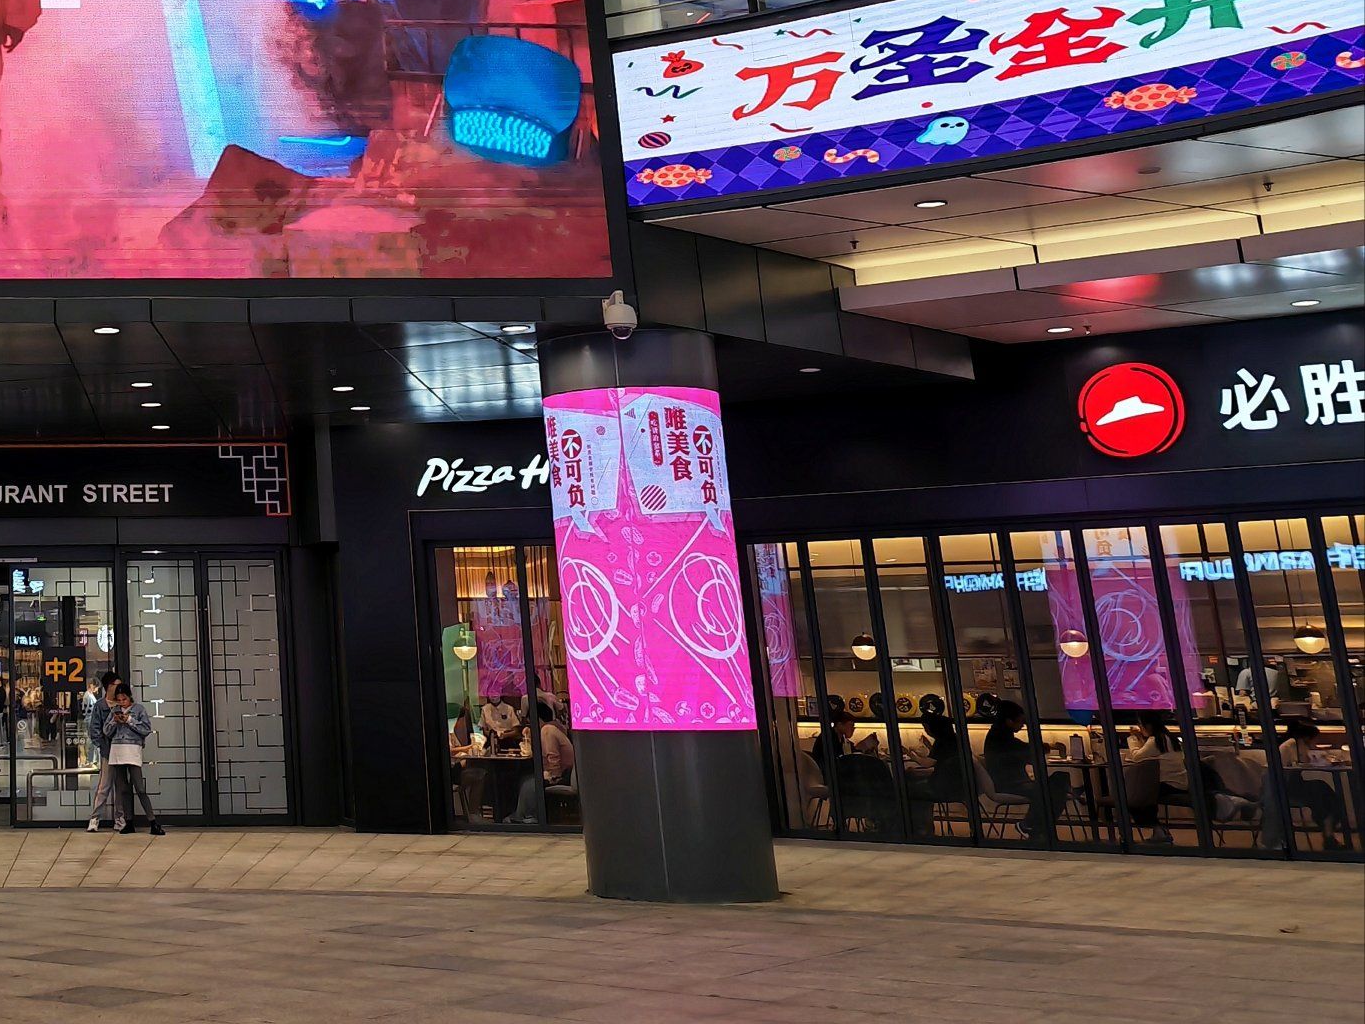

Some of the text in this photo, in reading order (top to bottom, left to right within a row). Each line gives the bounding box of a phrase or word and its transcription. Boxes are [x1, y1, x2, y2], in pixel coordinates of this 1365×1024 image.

[1218, 359, 1365, 432] 必胜
[416, 457, 516, 497] Pizza
[561, 432, 586, 508] 不可负
[664, 406, 693, 481] 唯美食
[694, 428, 718, 505] 不可负
[82, 483, 174, 504] STREET
[45, 657, 84, 682] 中2
